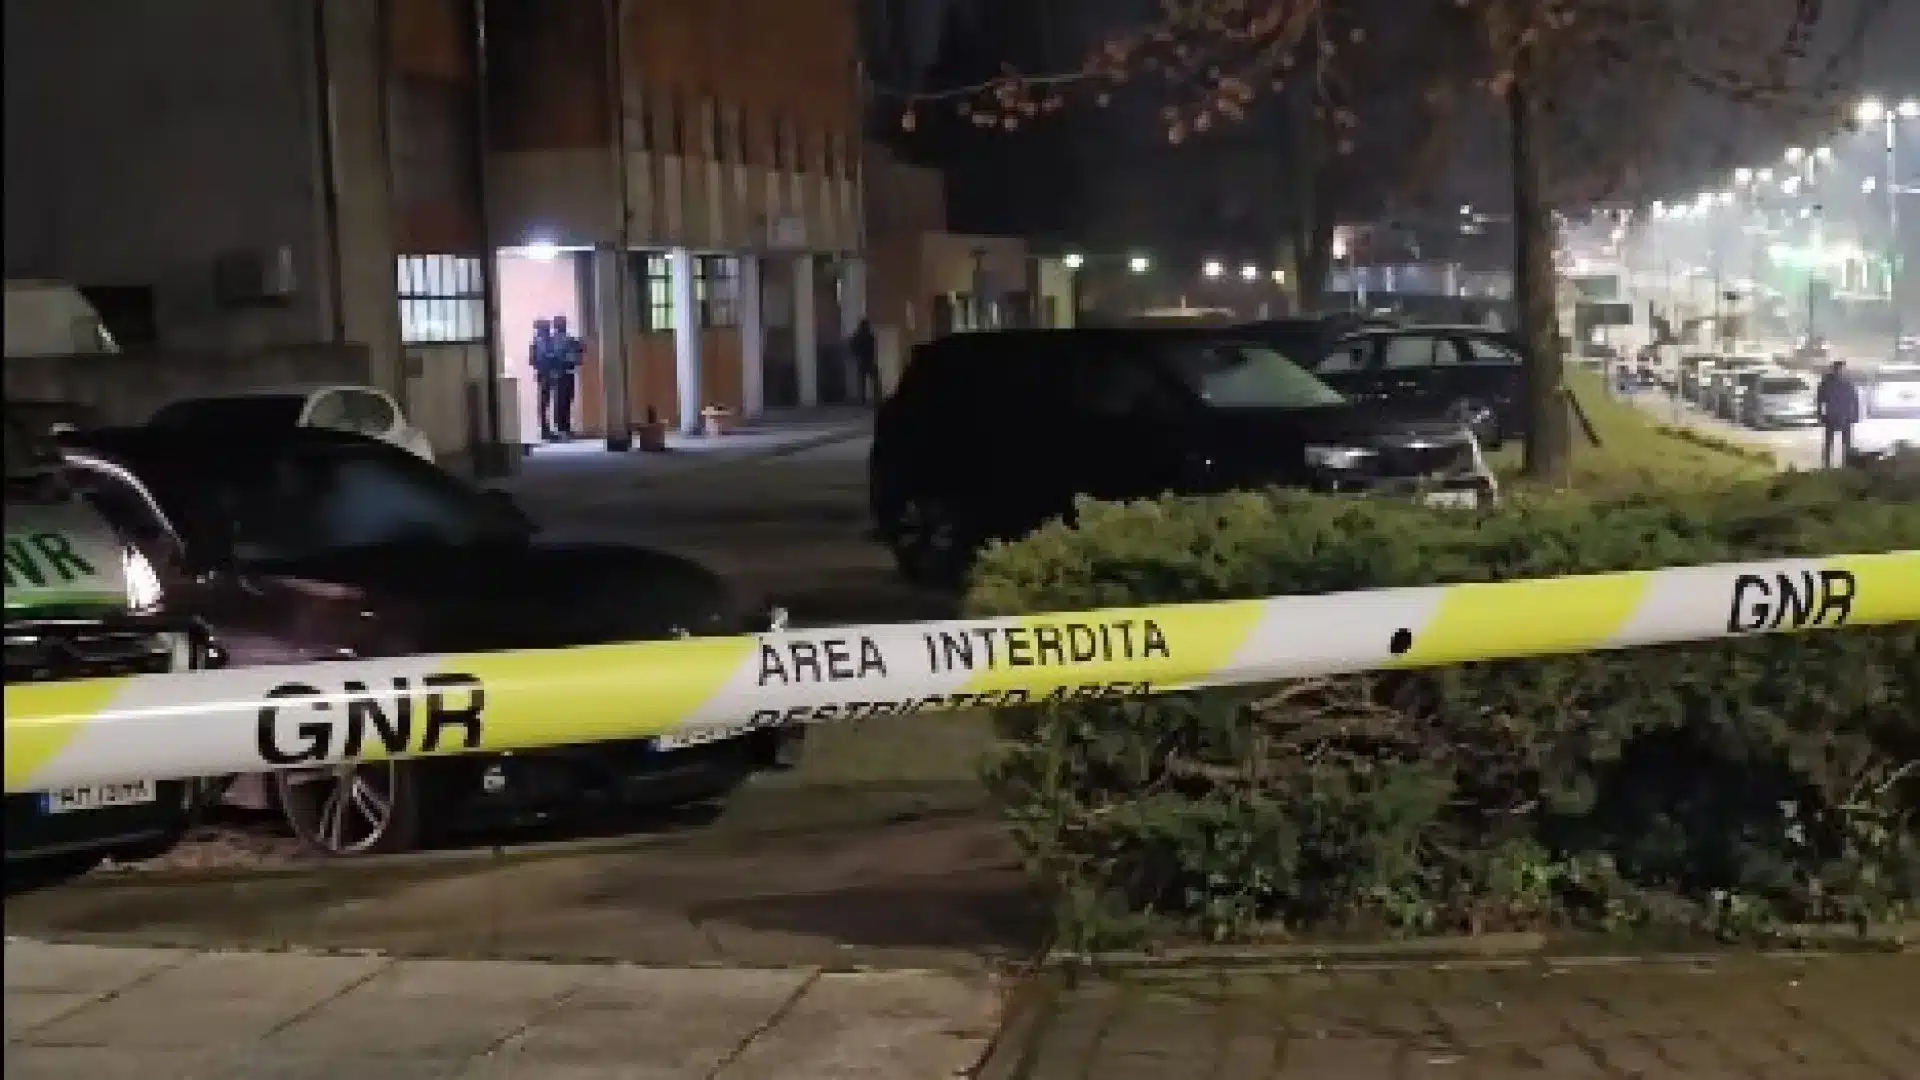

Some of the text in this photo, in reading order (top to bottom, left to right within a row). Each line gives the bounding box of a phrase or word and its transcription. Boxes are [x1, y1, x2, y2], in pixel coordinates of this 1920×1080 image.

[1727, 570, 1855, 632] GNR
[922, 618, 1171, 675] INTERDITA
[257, 672, 484, 765] GNR
